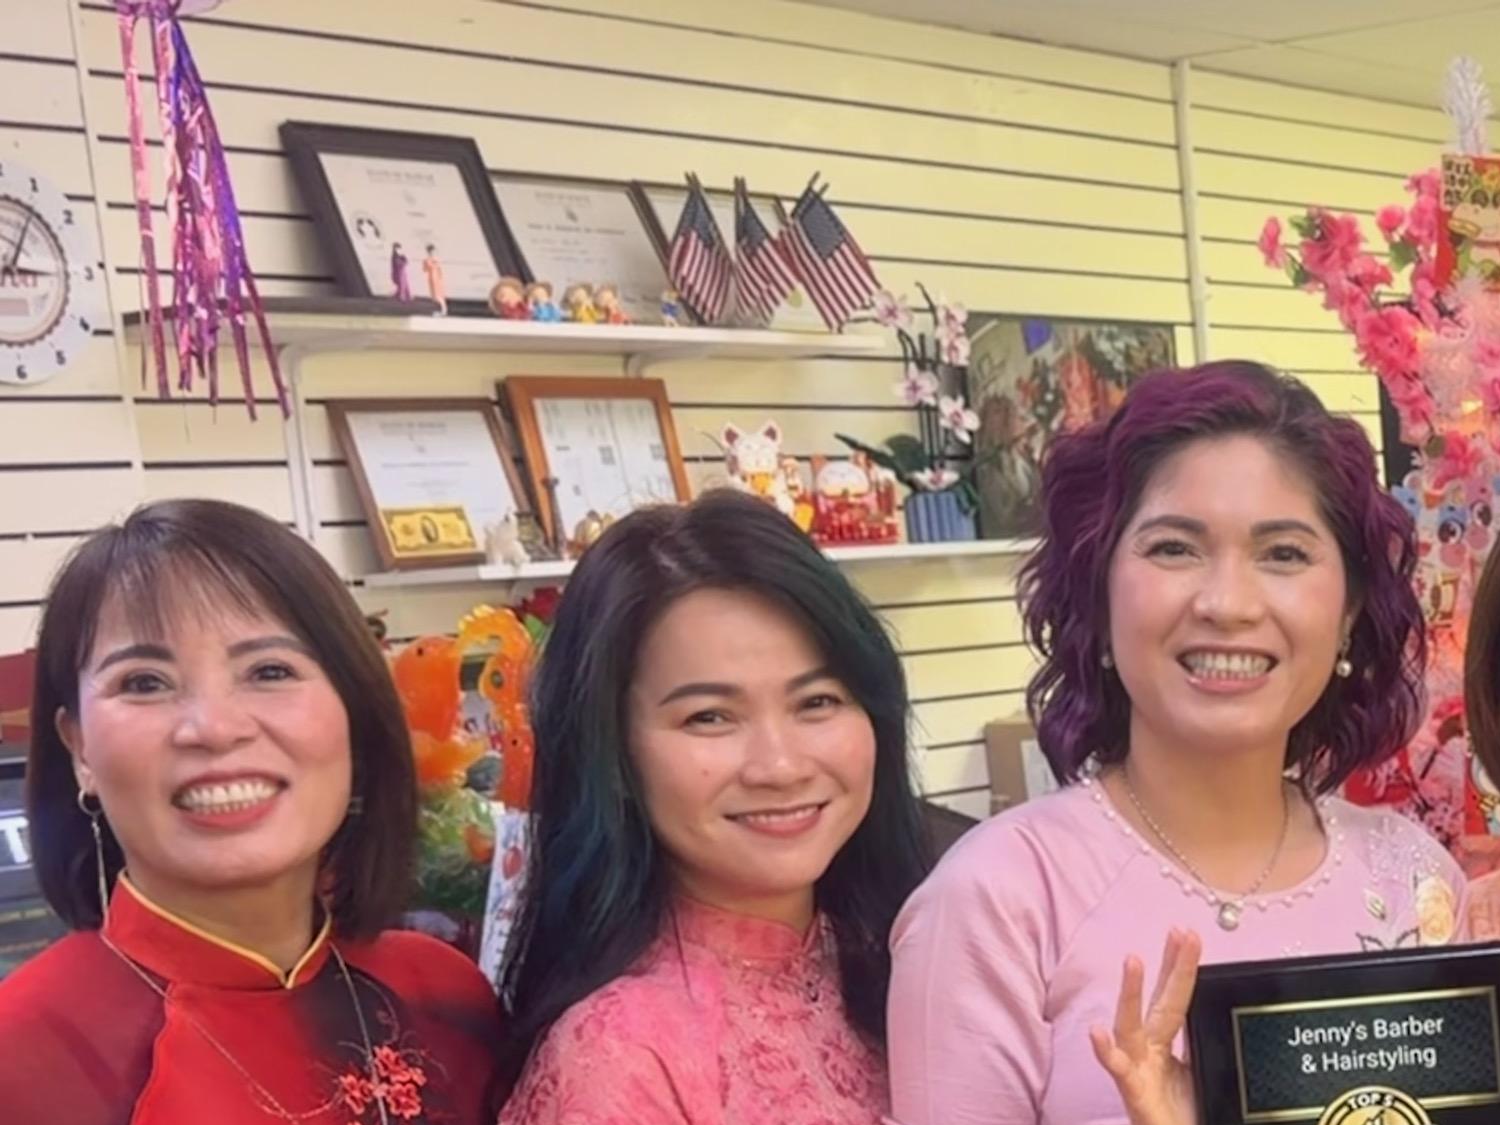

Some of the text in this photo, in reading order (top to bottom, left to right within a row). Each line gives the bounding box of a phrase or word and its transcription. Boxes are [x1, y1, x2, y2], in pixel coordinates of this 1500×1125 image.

[1288, 1016, 1444, 1047] Jenny's Barber
[1301, 1045, 1437, 1074] & Hairstyling
[1349, 1093, 1381, 1109] TOP
